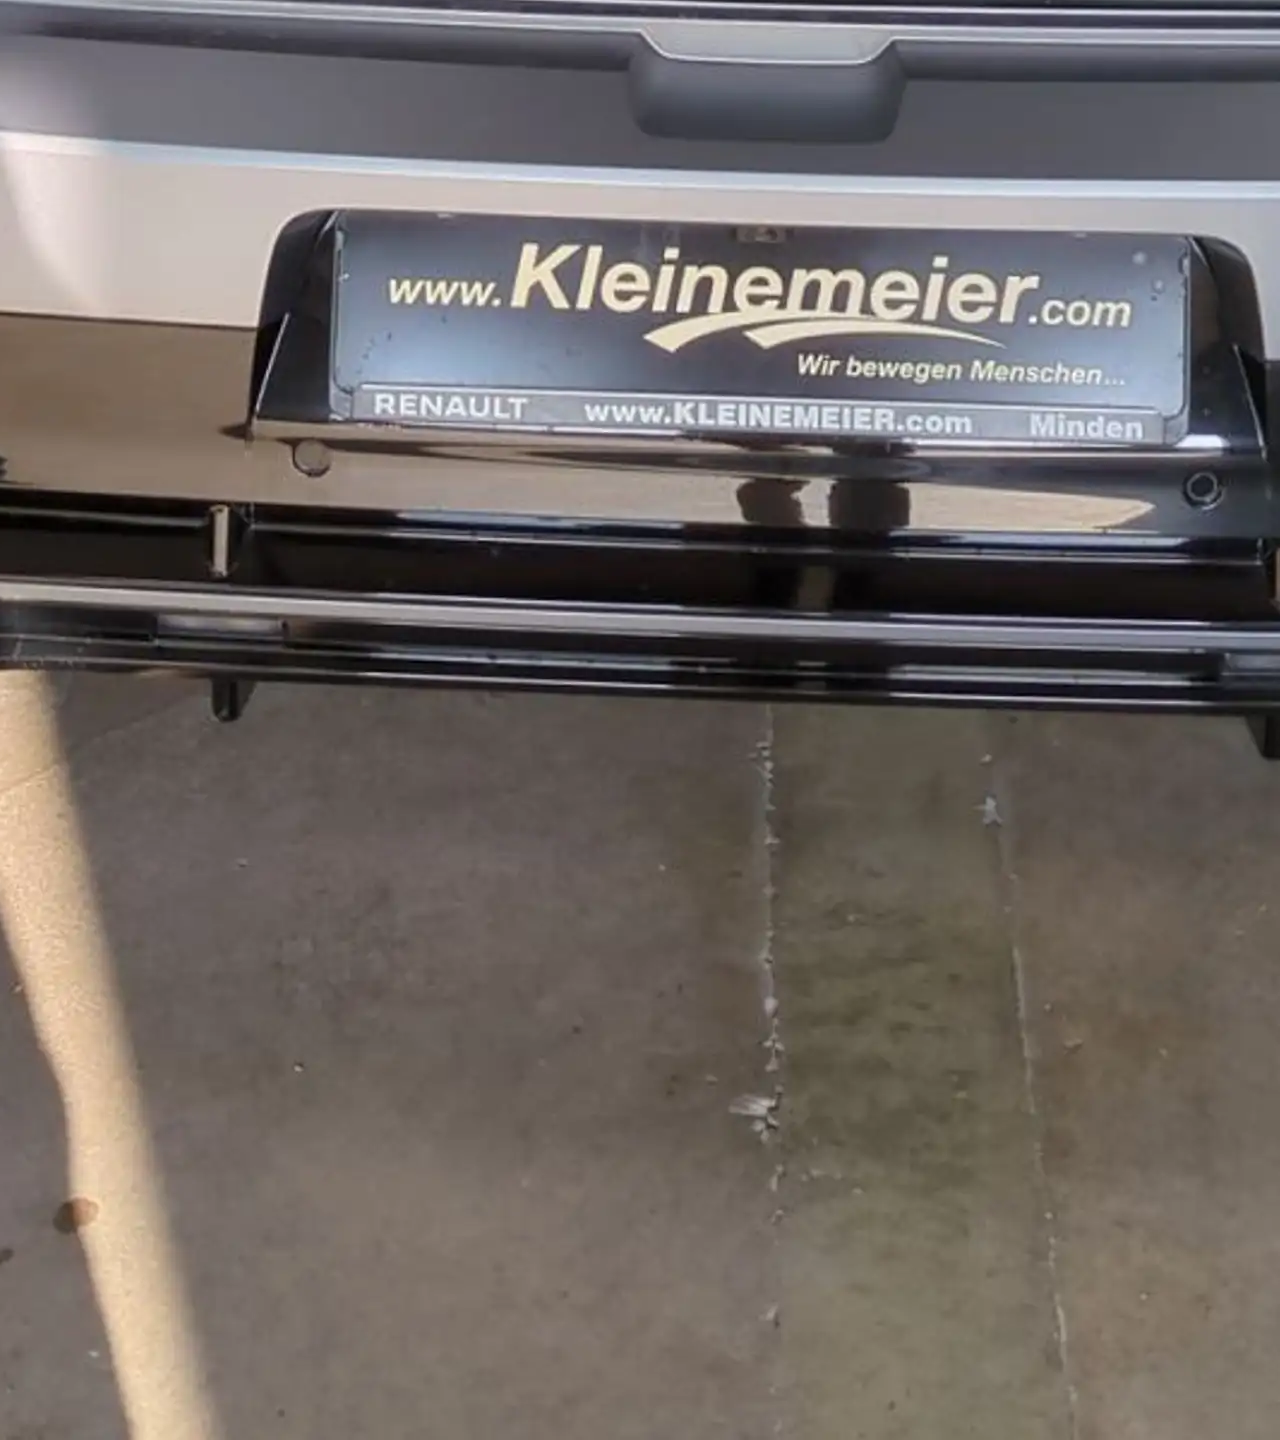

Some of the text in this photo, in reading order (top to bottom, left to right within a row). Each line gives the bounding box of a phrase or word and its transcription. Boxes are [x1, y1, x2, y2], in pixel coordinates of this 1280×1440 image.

[388, 242, 1132, 328] www.Kleinemeier.com
[796, 354, 1126, 386] Wir bewegen Menschen...
[373, 393, 1144, 440] RENAULT www.KLEINEMEIER.com Minden
